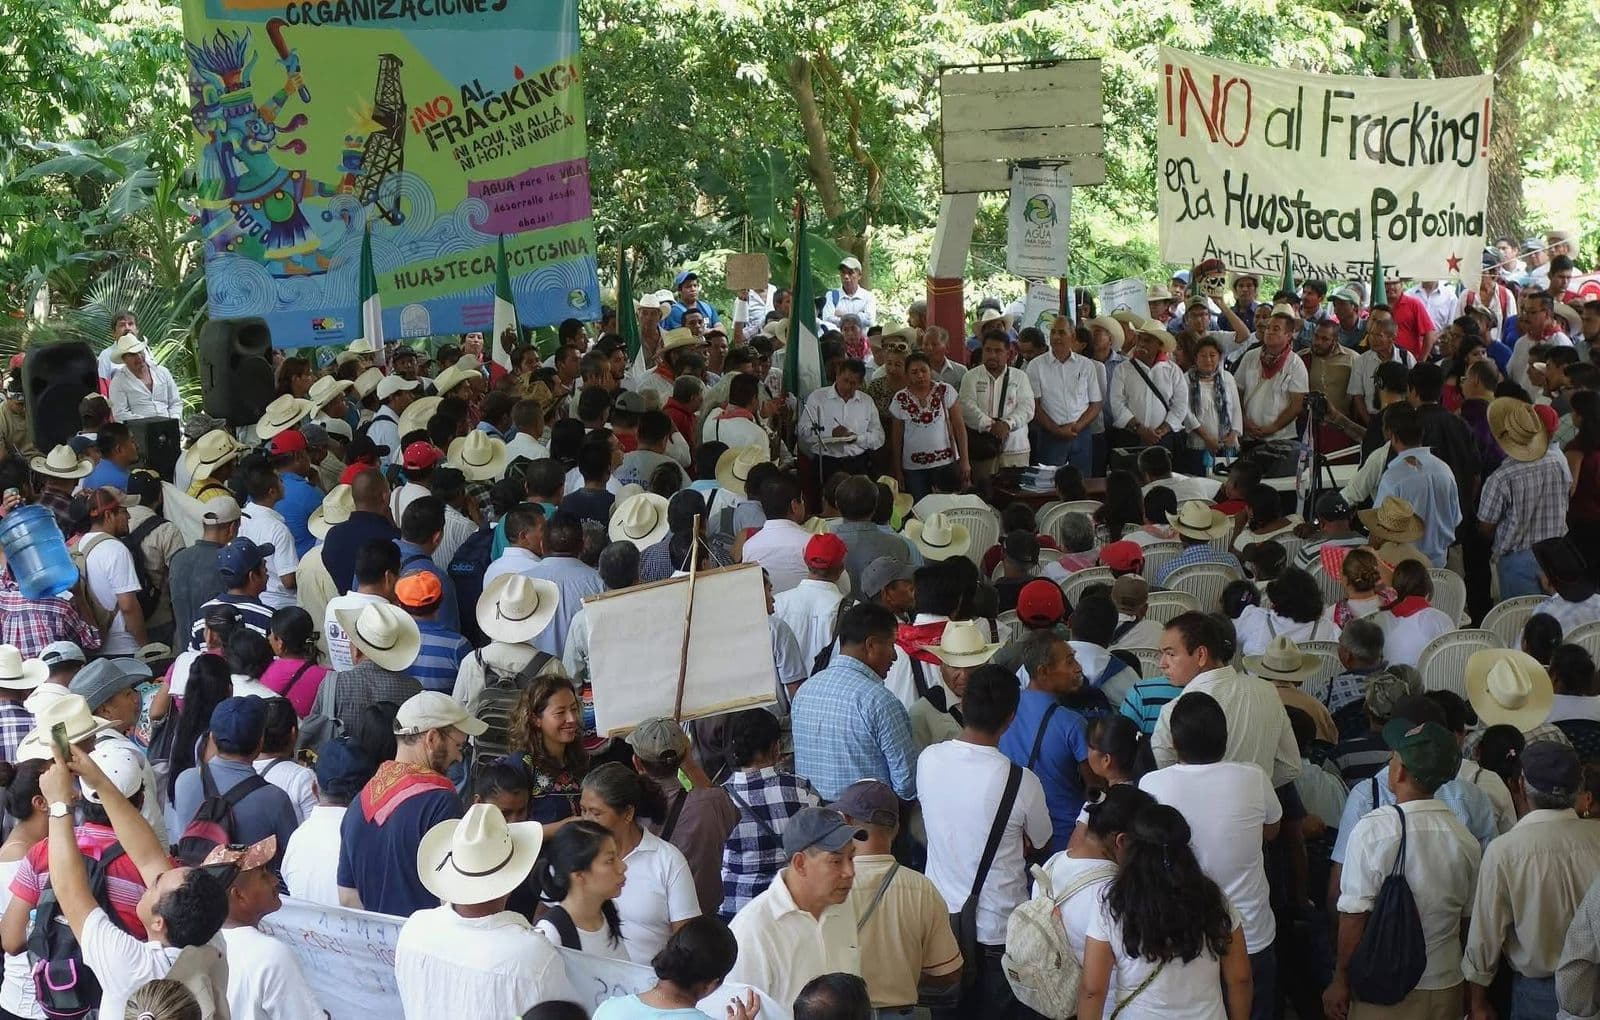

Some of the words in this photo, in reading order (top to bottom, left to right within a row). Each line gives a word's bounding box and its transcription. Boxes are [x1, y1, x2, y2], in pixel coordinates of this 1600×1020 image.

[423, 64, 579, 152] FRACKING!
[460, 78, 494, 108] AL
[1164, 63, 1254, 148] ¡NO
[1264, 85, 1303, 151] al
[509, 120, 525, 134] NI
[460, 156, 475, 172] NI
[512, 137, 527, 150] NI
[520, 179, 541, 190] para
[546, 173, 555, 182] la
[1164, 156, 1200, 192] en
[494, 195, 544, 213] desarrollo
[549, 187, 576, 201] desde
[1175, 186, 1214, 223] la
[1223, 169, 1361, 242] Huasteca
[1370, 186, 1484, 243] Potosina
[1025, 229, 1051, 239] AGUA
[393, 255, 498, 290] HUASTECA
[505, 235, 589, 269] POTOSINA
